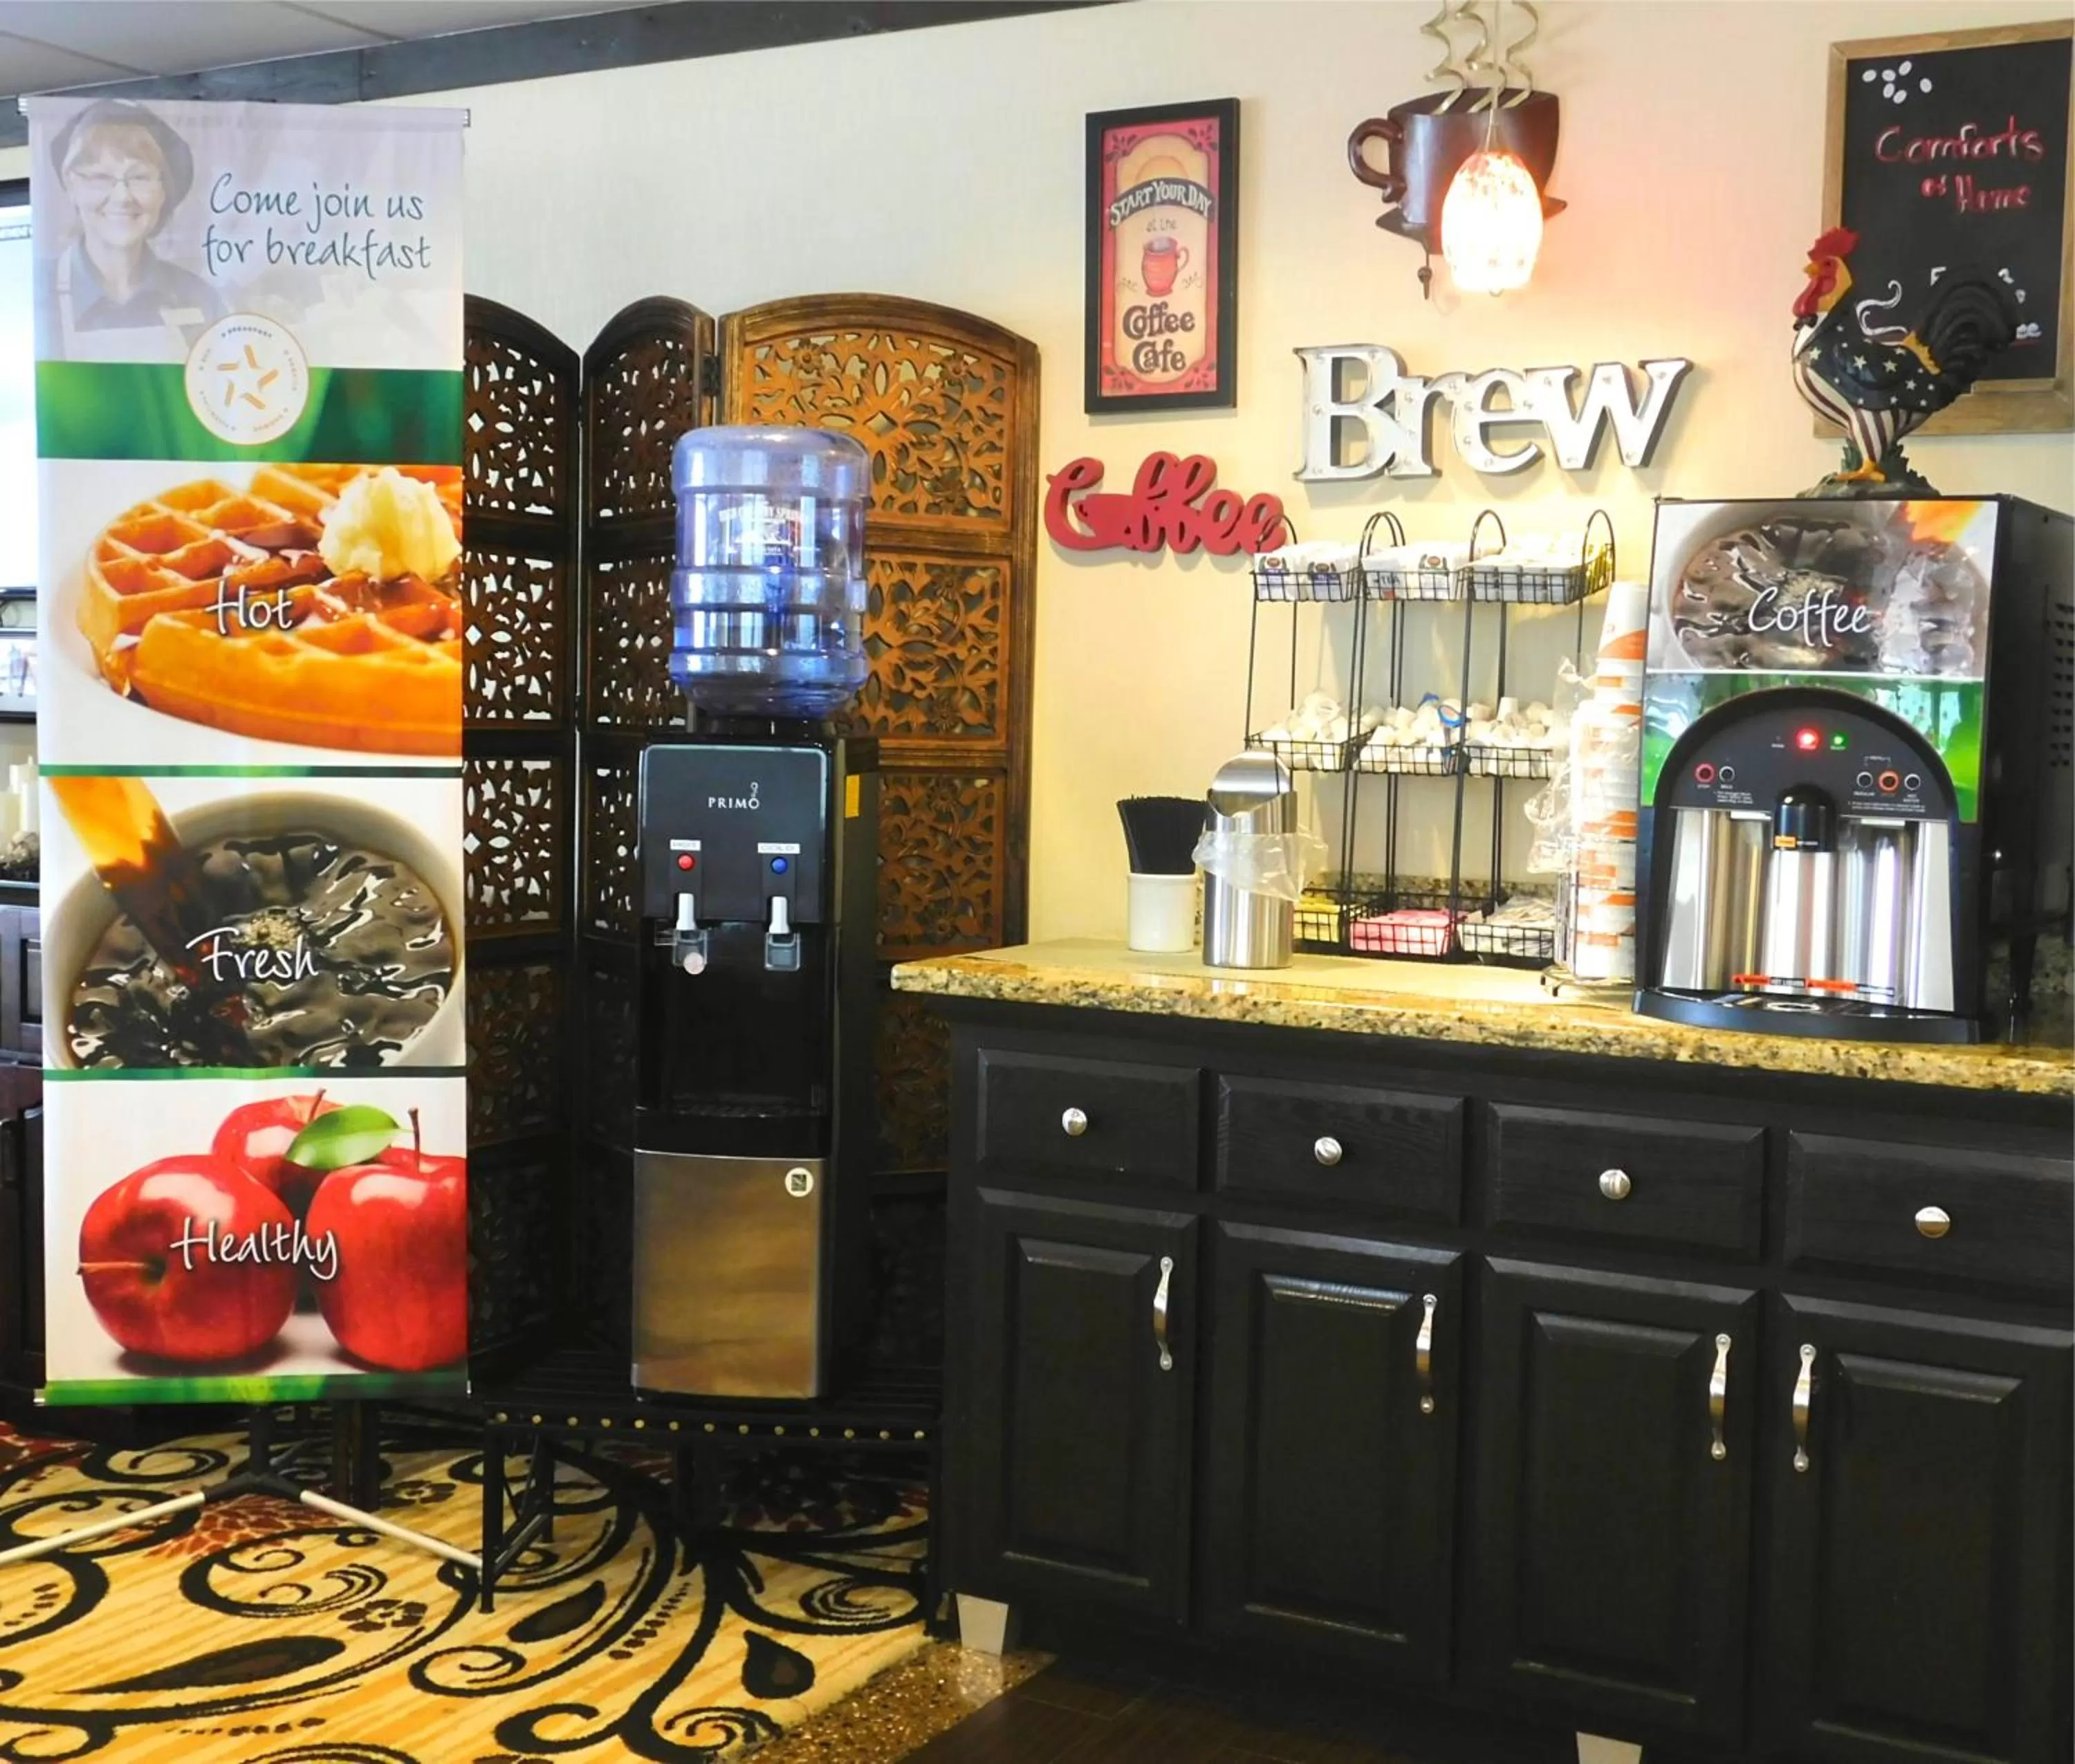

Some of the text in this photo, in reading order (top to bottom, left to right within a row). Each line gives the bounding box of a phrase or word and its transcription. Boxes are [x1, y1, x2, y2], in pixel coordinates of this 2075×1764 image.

[1875, 114, 2045, 163] Comforts
[210, 172, 424, 234] Come join us
[1110, 181, 1212, 226] START YOUR DAY
[201, 223, 432, 281] for breakfast
[1123, 301, 1195, 340] Coffee
[1132, 338, 1186, 374] Cafe
[1292, 343, 1694, 481] Brew
[1044, 450, 1288, 558] Coffee
[203, 580, 295, 634] Hot
[1748, 585, 1874, 647] Coffee
[708, 796, 759, 810] PRIMO
[185, 926, 319, 982] Fresh
[170, 1217, 338, 1280] Healthy
